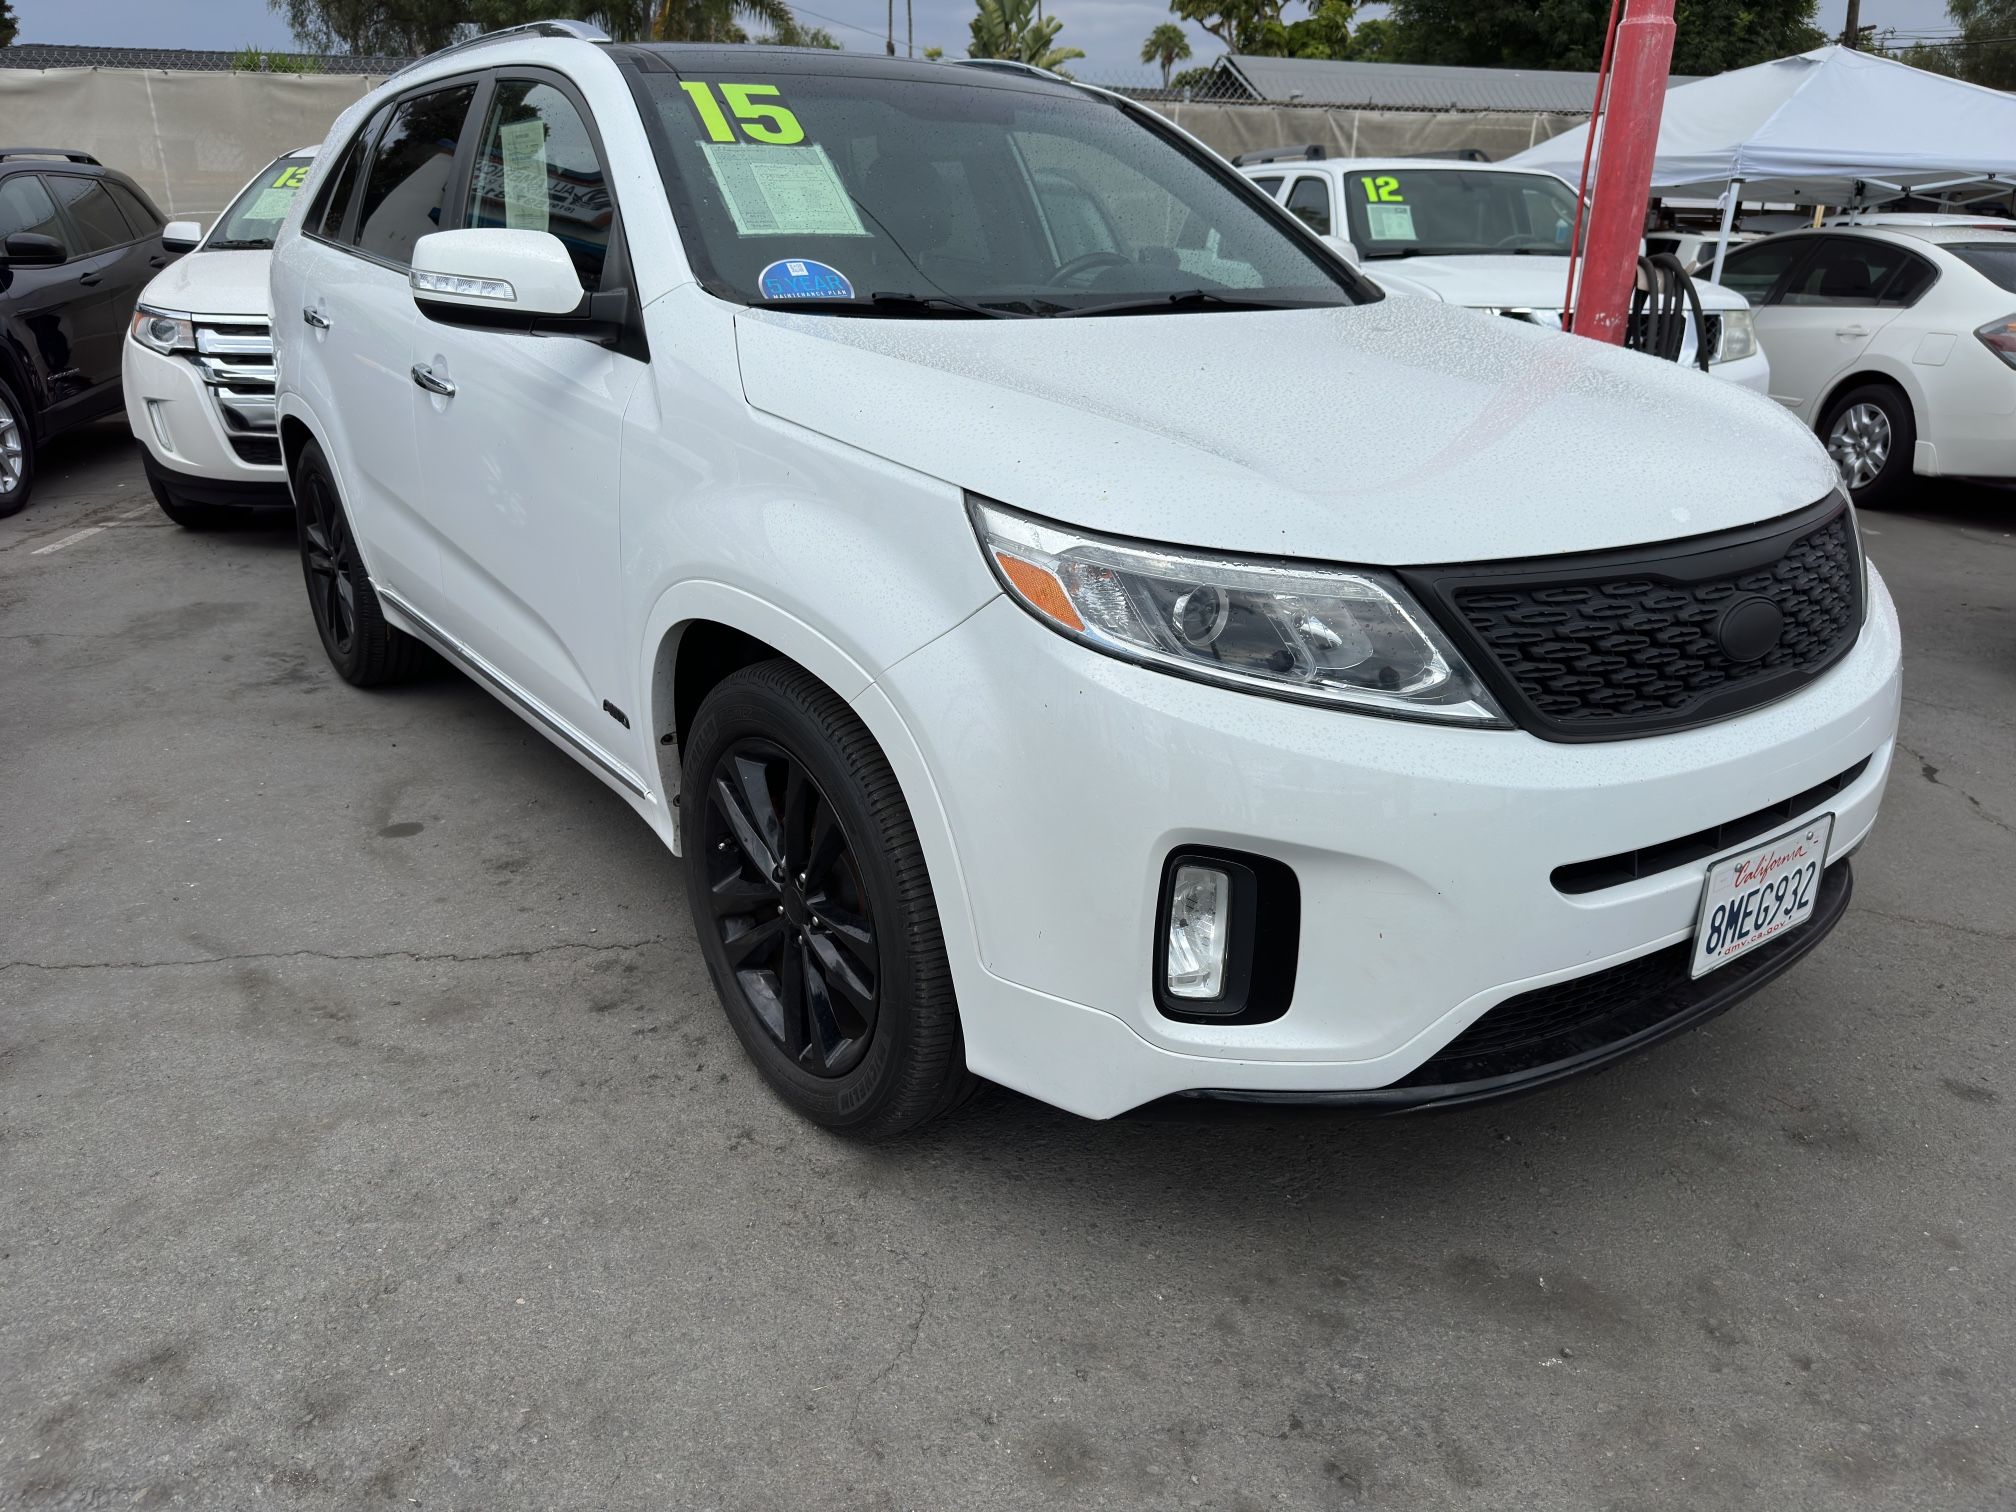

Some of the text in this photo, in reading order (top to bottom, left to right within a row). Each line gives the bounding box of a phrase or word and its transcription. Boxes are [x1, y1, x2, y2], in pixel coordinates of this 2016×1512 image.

[680, 81, 805, 145] 15
[272, 166, 311, 188] 13
[1361, 176, 1404, 203] 12
[765, 275, 843, 294] 5 YEAR
[773, 289, 847, 299] MAINTENANCE PLAN
[1734, 845, 1807, 888] California
[1706, 861, 1816, 955] 8MEG932
[1724, 920, 1786, 956] dmv.ca.gov
